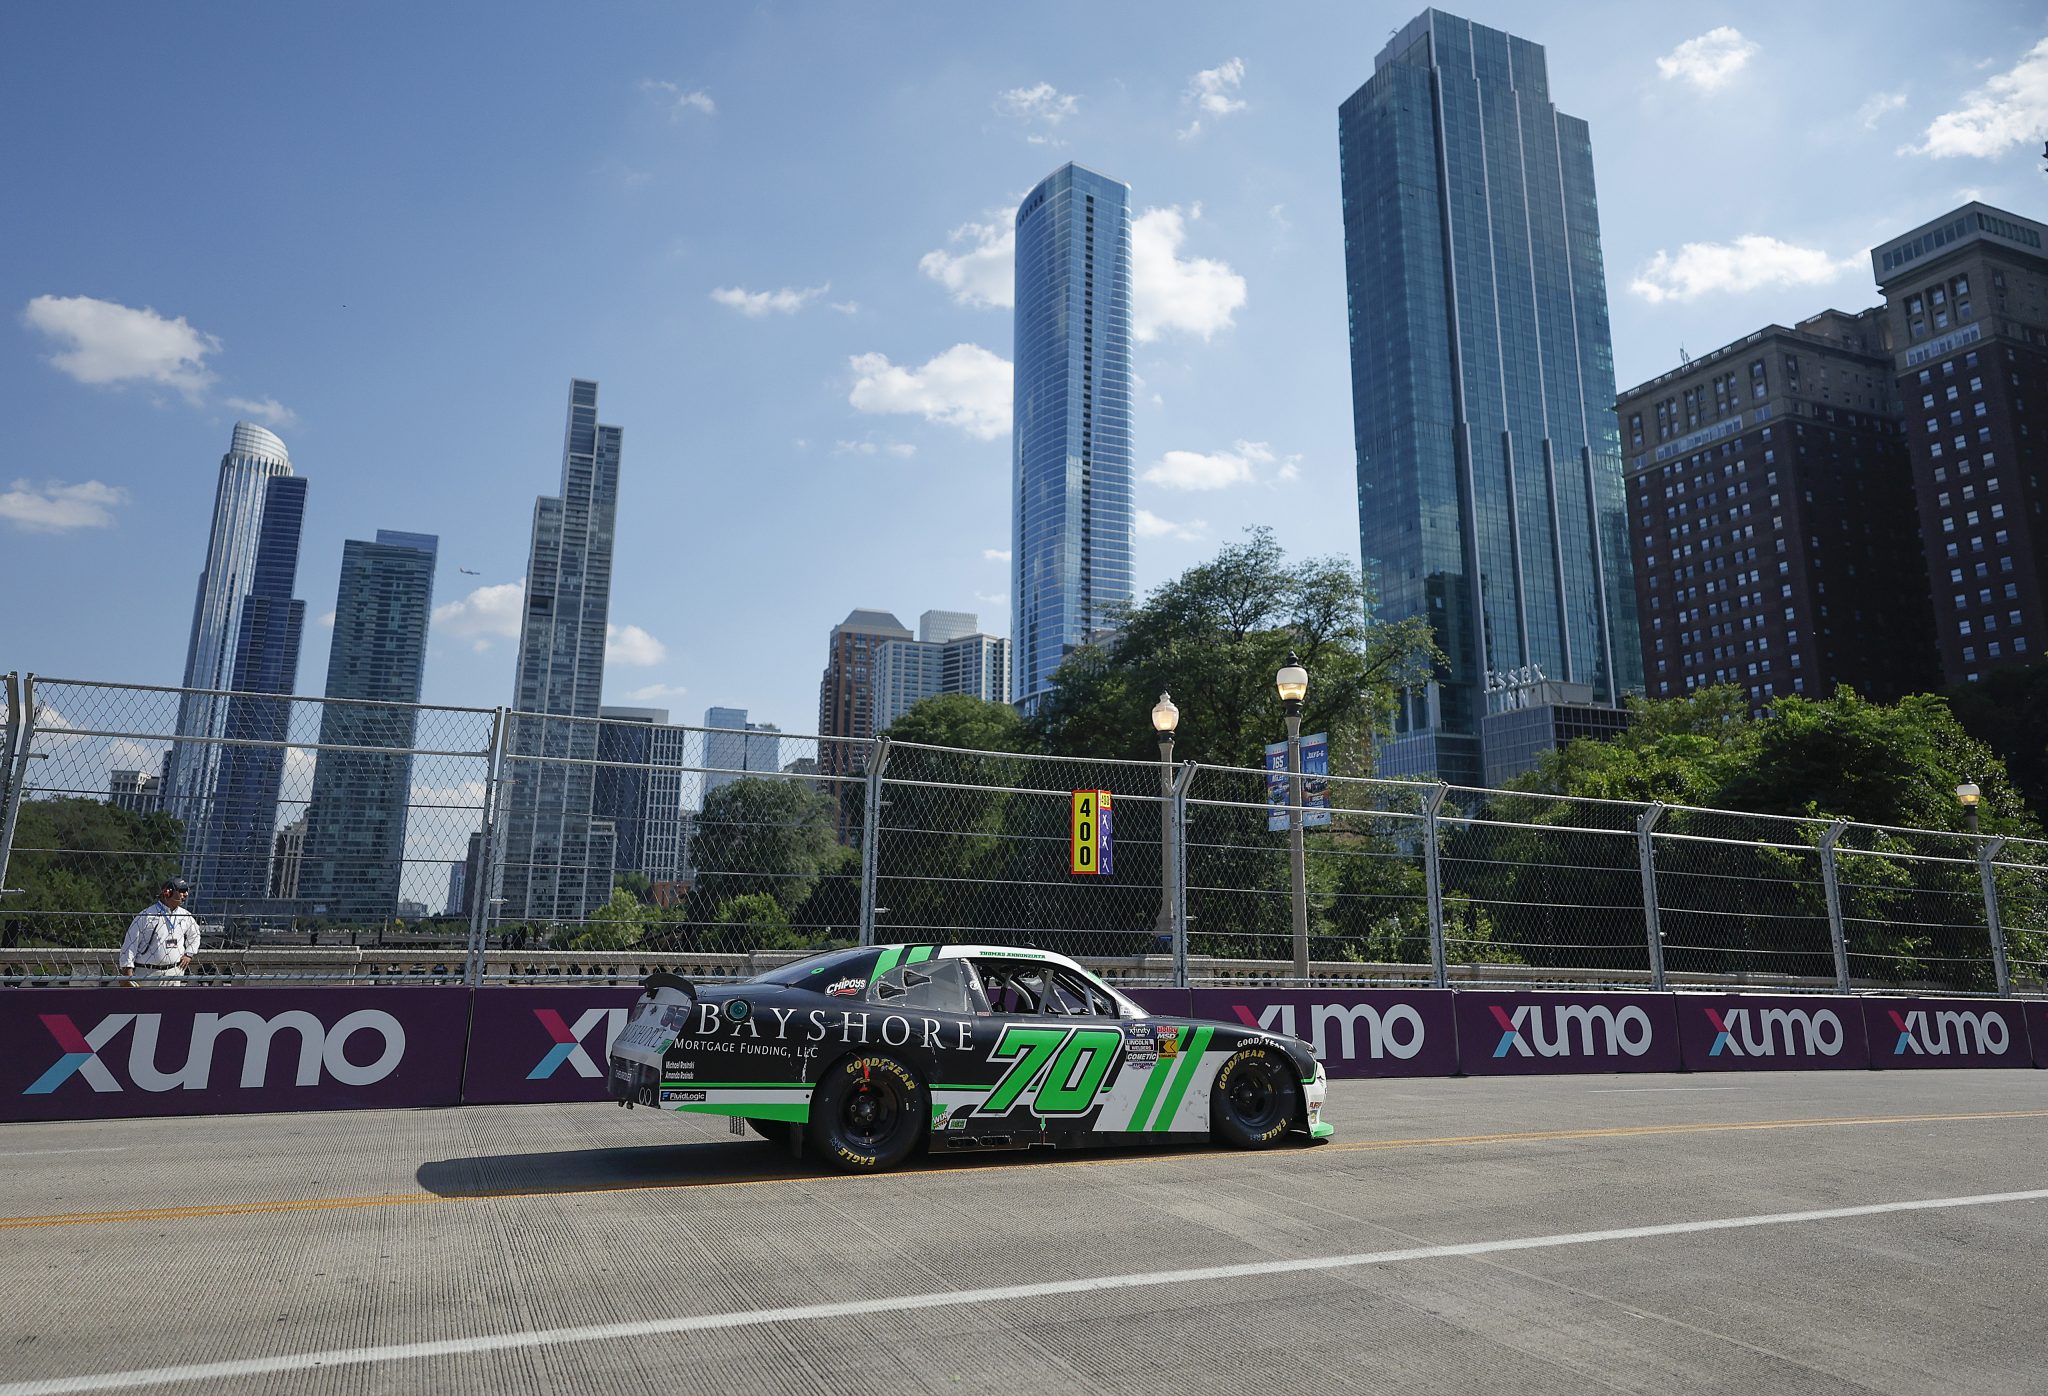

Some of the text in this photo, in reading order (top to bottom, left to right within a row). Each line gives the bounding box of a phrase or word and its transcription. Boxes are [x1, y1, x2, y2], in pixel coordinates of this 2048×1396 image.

[1272, 755, 1284, 769] 165
[1080, 798, 1091, 866] 400
[826, 976, 866, 994] CHIPOYS
[696, 1003, 975, 1051] BAYSHORE
[674, 1038, 735, 1053] MORTGAGE
[740, 1042, 791, 1058] FUNDING,
[797, 1047, 819, 1058] LLC
[1236, 1036, 1286, 1051] GOODYEAR
[846, 1057, 916, 1090] GOODYEAR
[970, 1023, 1125, 1118] 70
[1219, 1049, 1265, 1090] GOODYEAR
[1261, 1117, 1287, 1141] EAGLE
[838, 1147, 876, 1166] EAGLE
